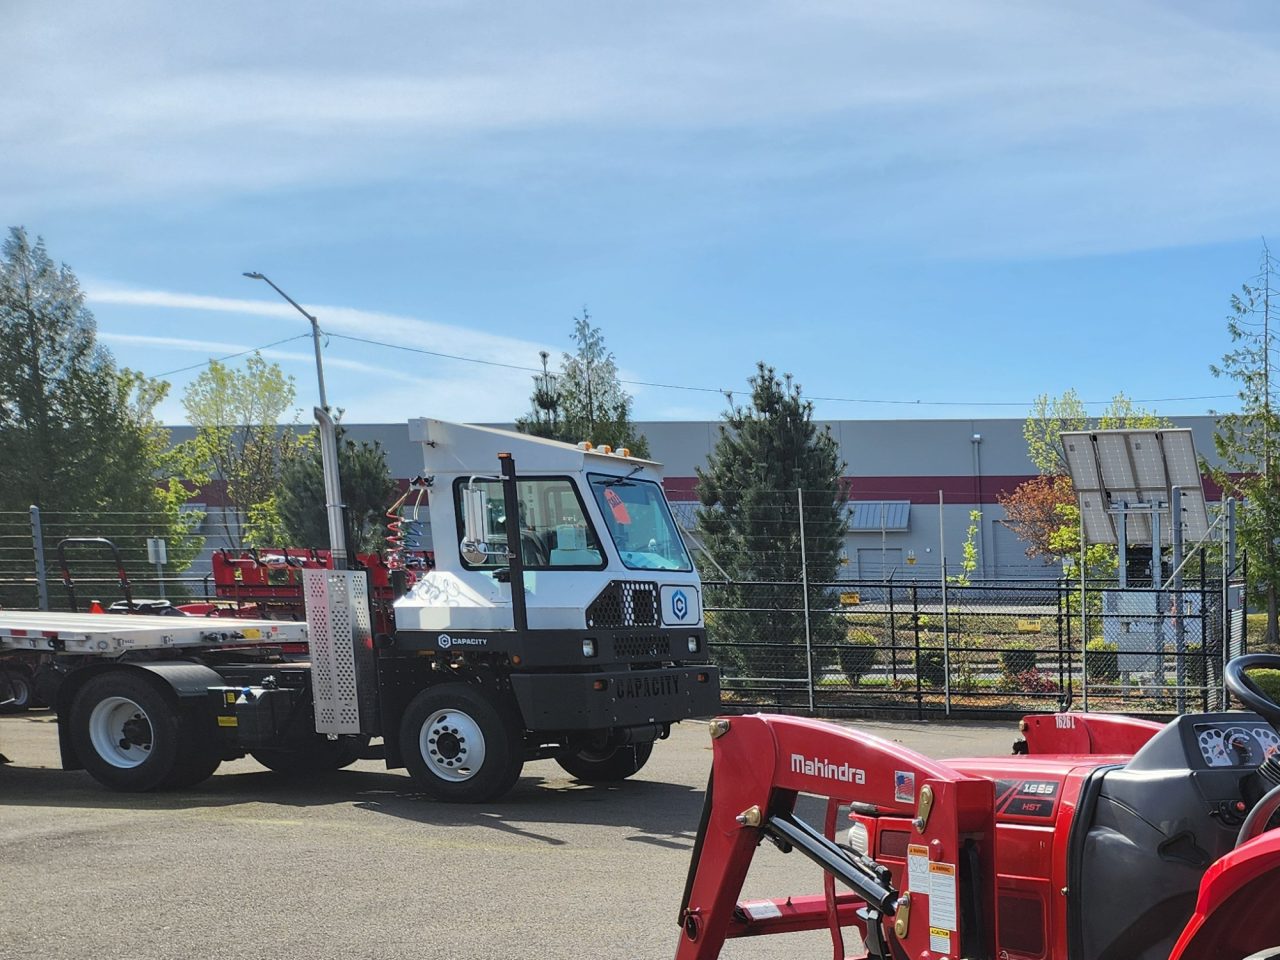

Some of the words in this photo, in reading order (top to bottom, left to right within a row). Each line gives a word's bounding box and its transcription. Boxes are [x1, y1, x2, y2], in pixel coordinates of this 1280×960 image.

[616, 674, 680, 699] CAPACITY
[791, 753, 866, 785] Mahindra
[1022, 803, 1041, 811] HST
